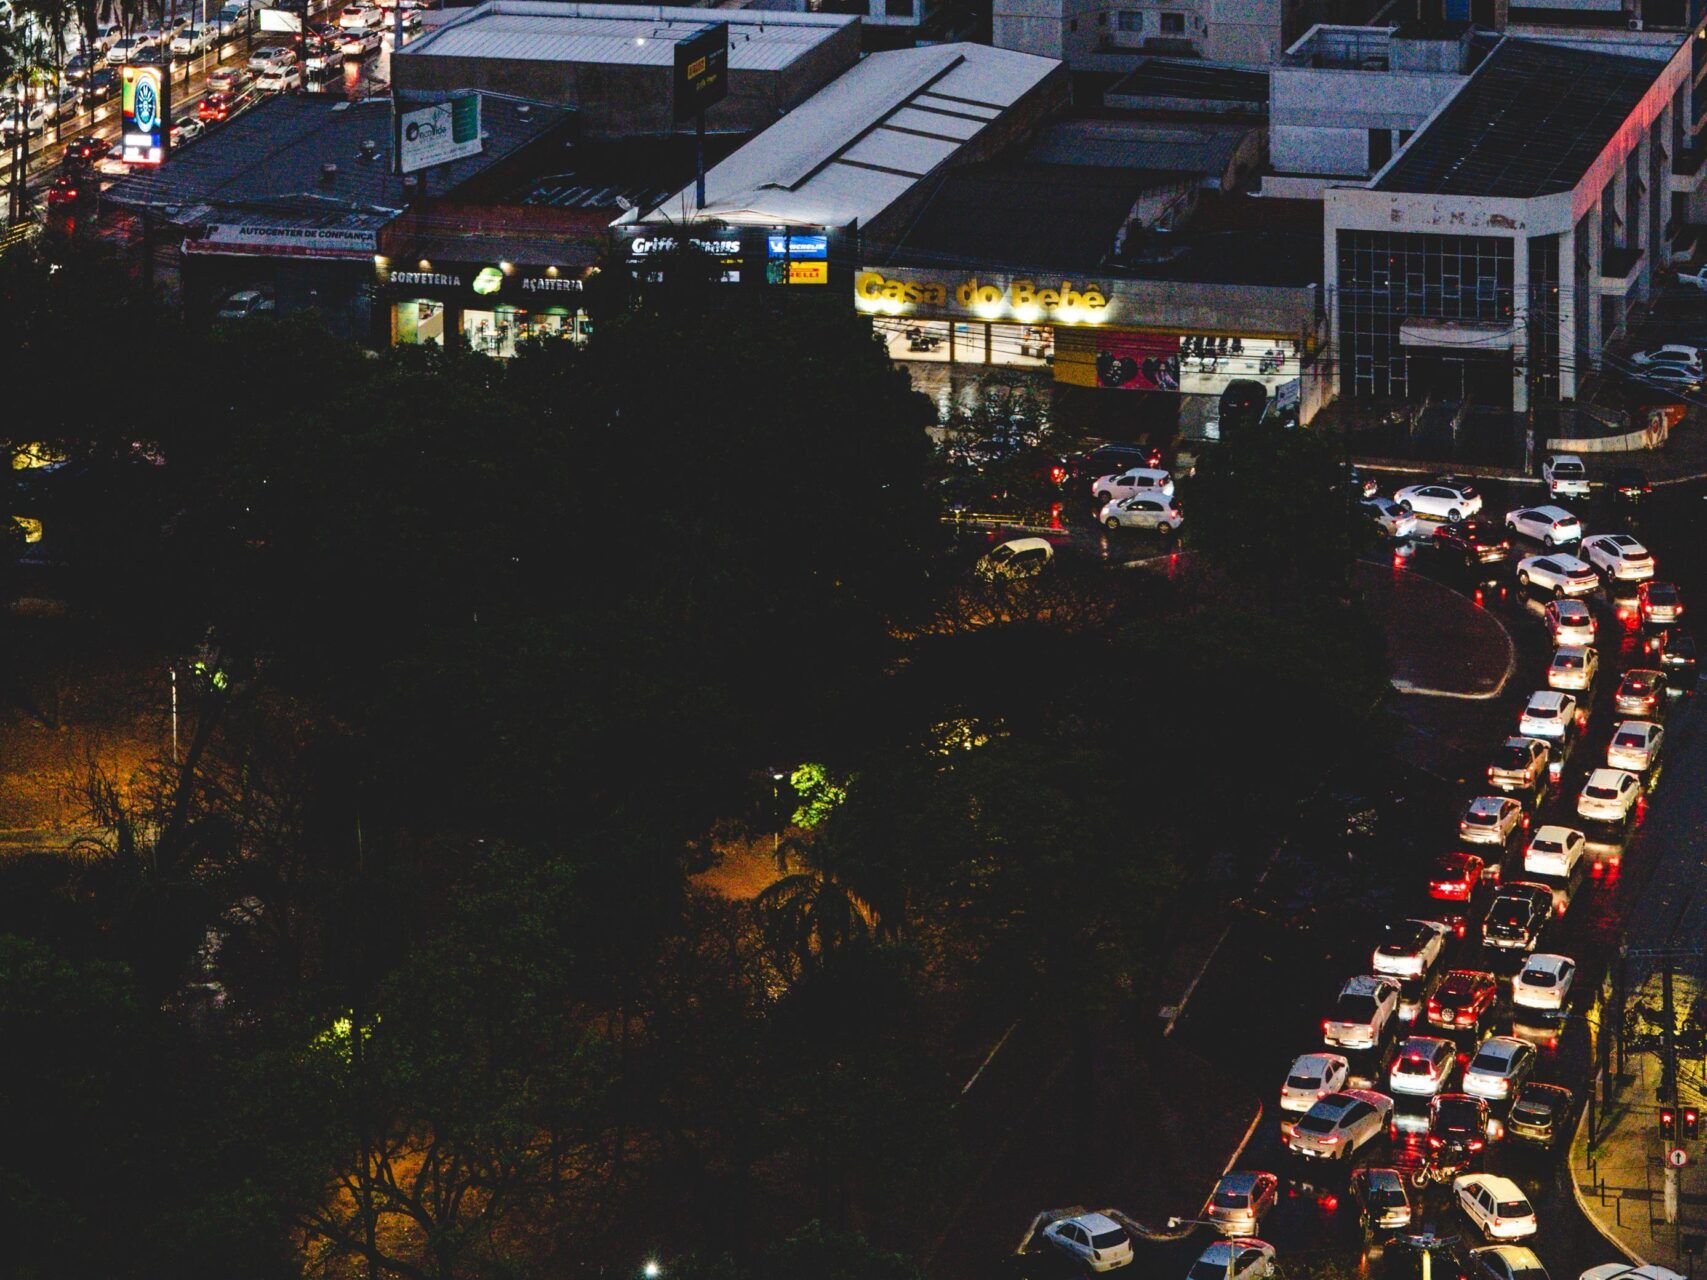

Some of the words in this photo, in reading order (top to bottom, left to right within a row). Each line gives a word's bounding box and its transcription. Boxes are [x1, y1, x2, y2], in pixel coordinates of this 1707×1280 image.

[239, 226, 303, 237] AUTOCENTER
[304, 228, 317, 238] DE
[318, 229, 374, 243] CONFIANÇA
[390, 271, 461, 286] SORVETERIA
[522, 278, 584, 292] AÇAITERIA
[856, 272, 947, 307] Casa
[956, 276, 1002, 308] do
[1009, 277, 1107, 313] Bebê
